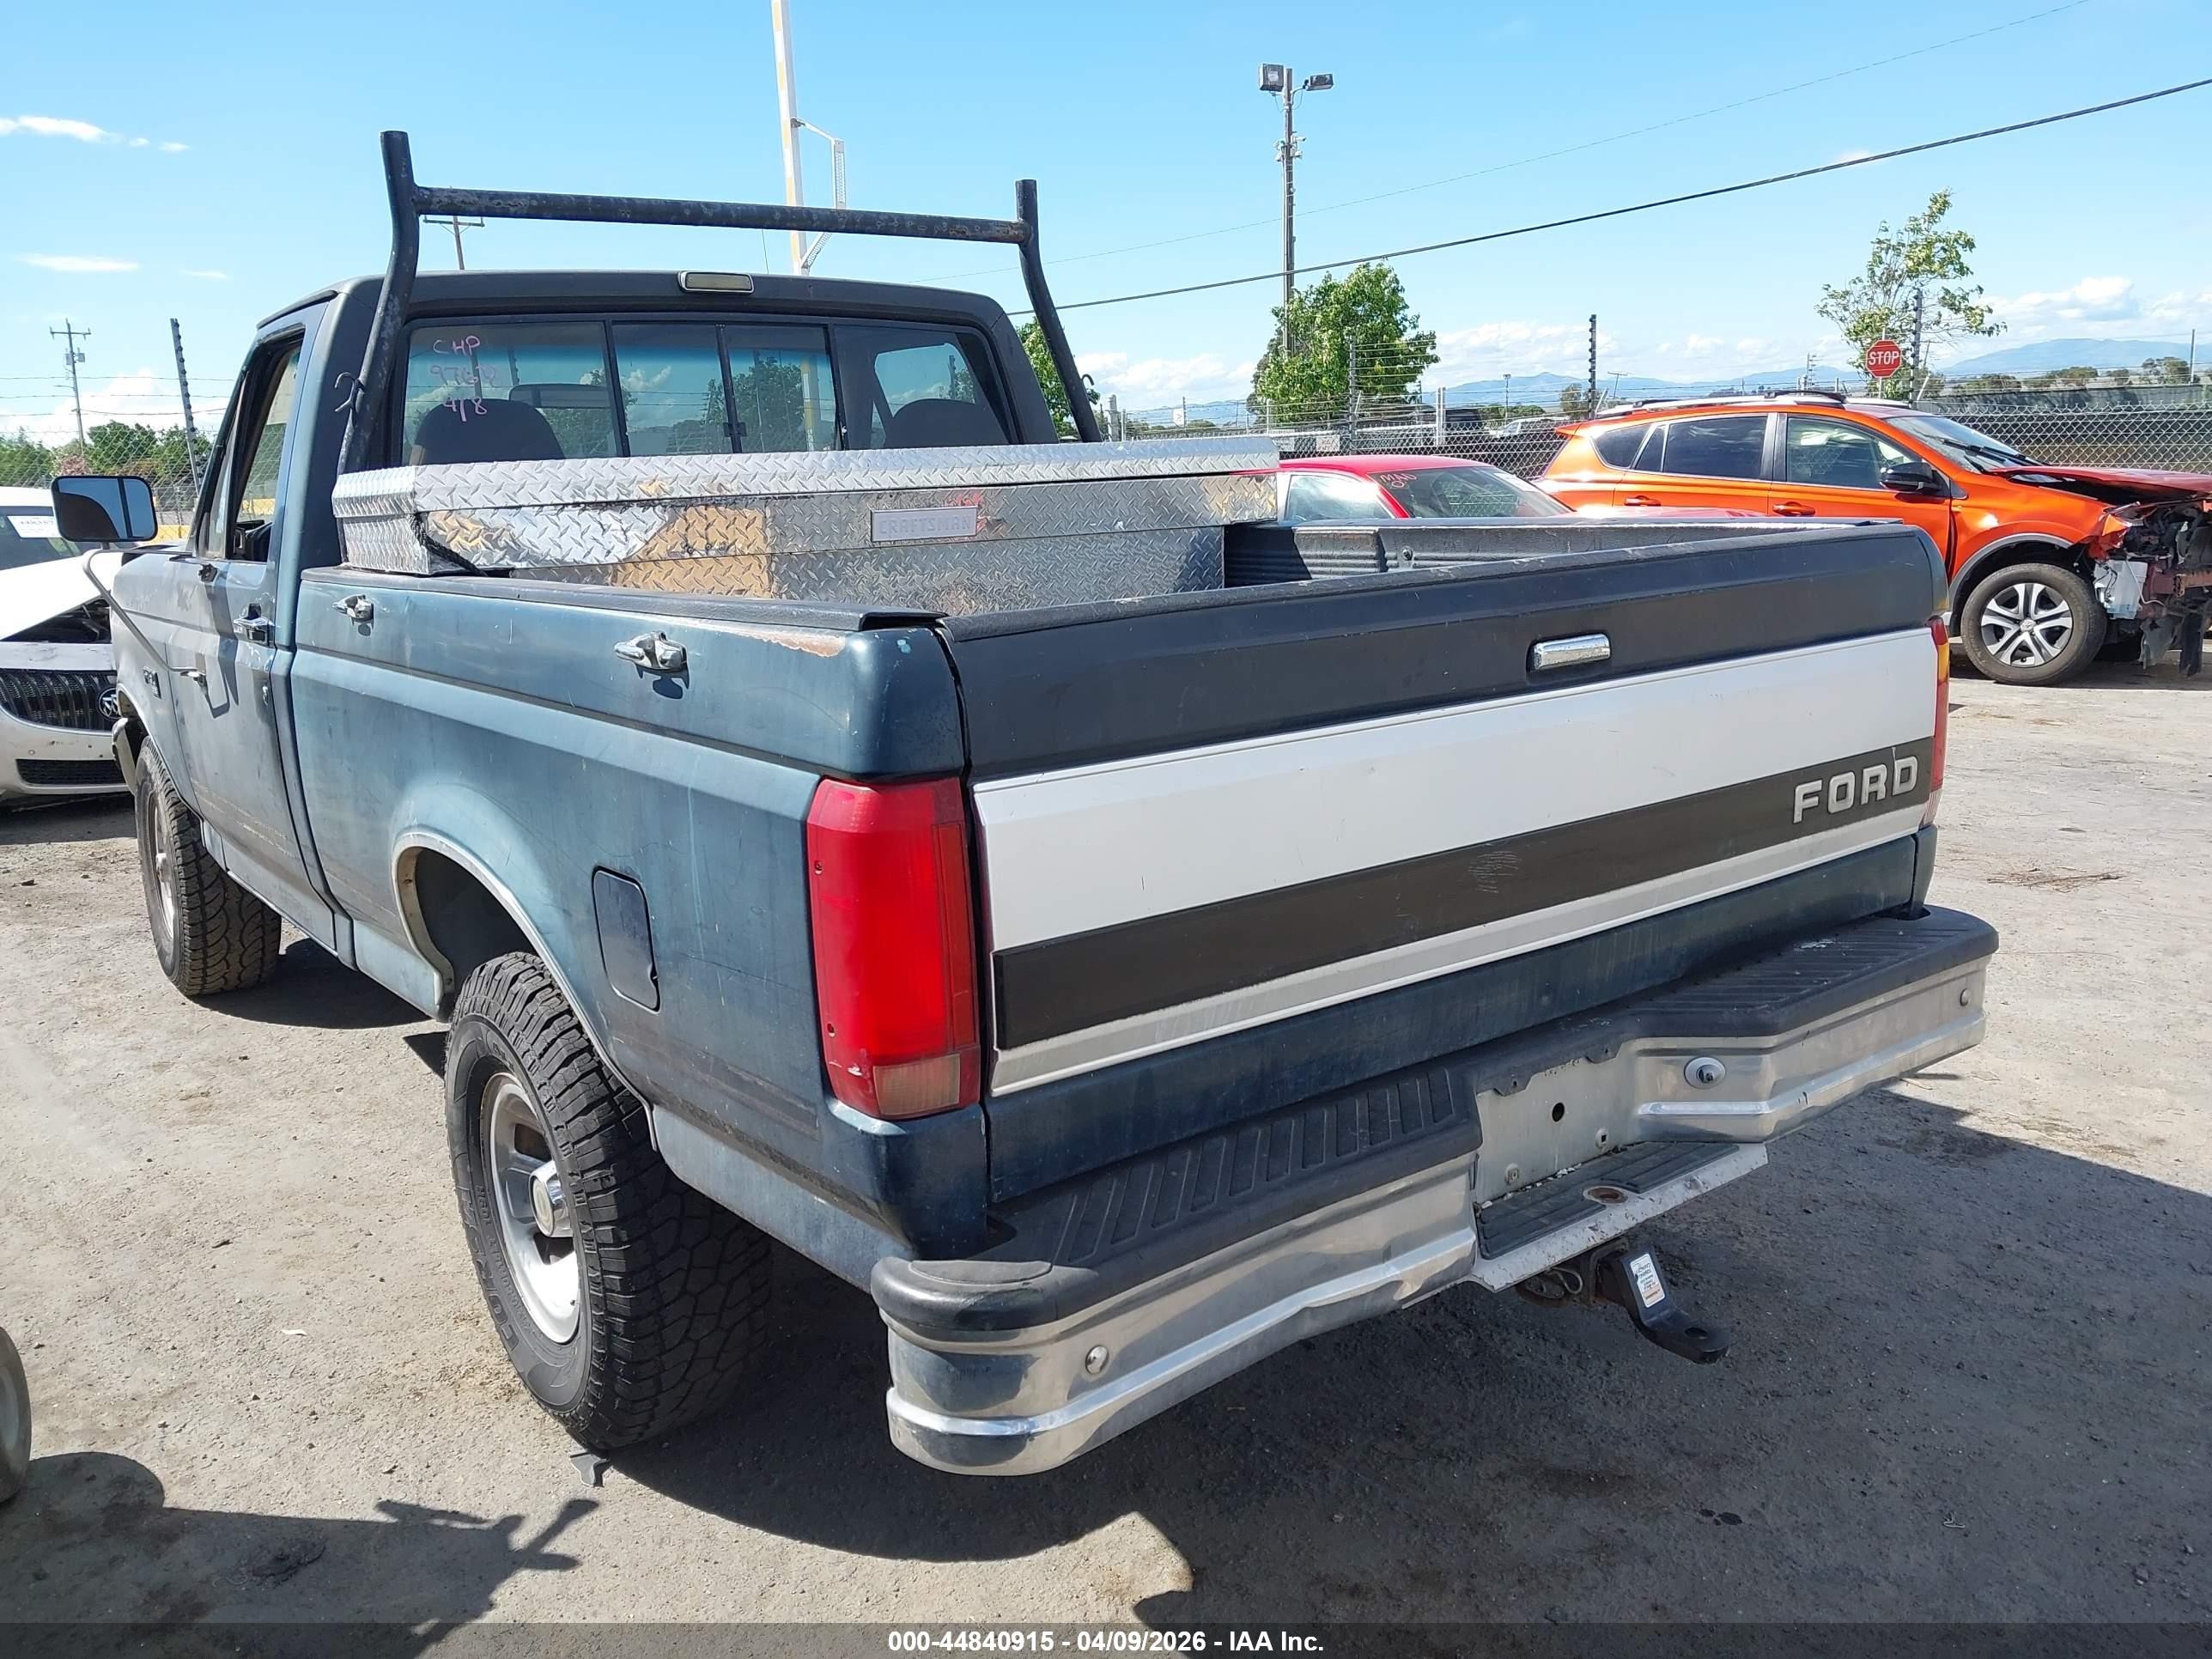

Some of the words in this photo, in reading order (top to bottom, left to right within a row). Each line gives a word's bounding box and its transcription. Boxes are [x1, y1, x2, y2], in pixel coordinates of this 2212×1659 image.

[433, 335, 481, 356] CHP
[1869, 351, 1899, 366] STOP
[879, 516, 971, 534] CRAFTSMAN
[1793, 755, 1918, 824] FORD
